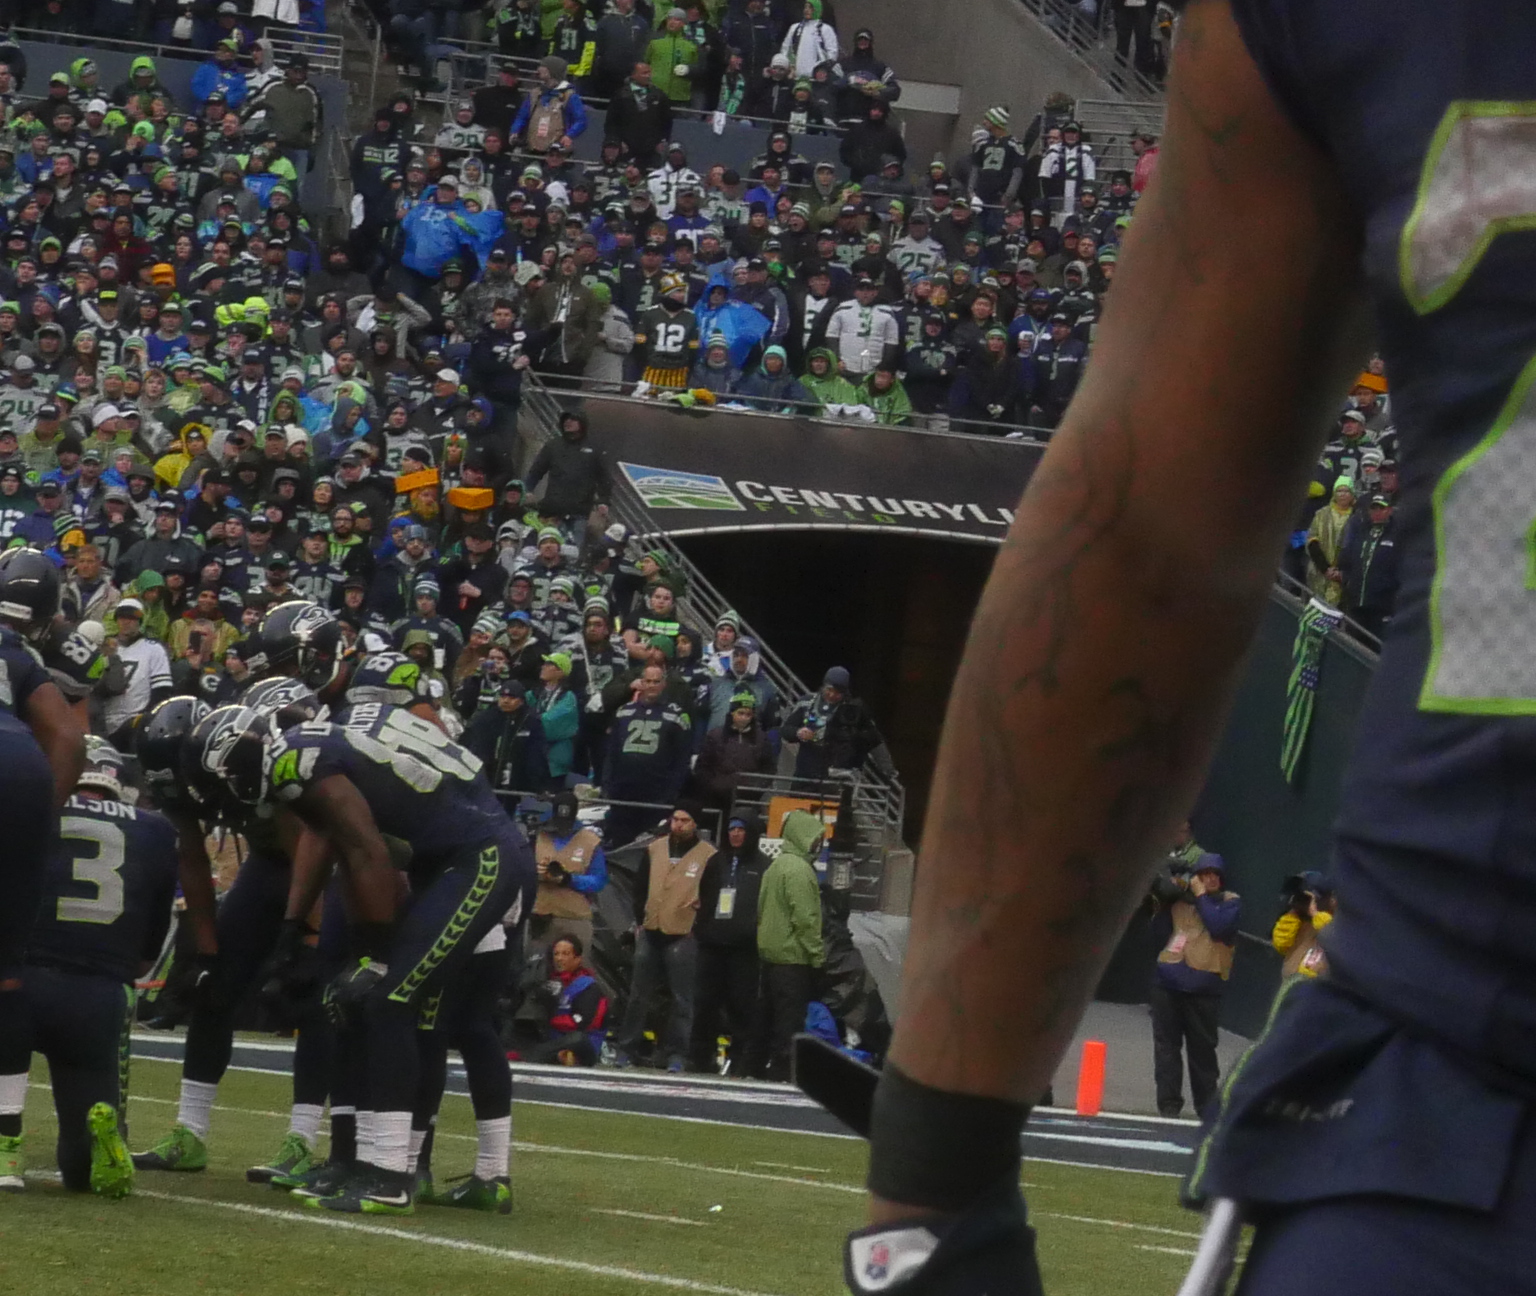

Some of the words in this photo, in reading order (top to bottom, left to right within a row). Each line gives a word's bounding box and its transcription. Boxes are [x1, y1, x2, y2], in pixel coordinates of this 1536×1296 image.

[897, 252, 931, 275] 25
[637, 285, 657, 312] 3
[654, 322, 686, 353] 12
[907, 315, 925, 343] 3
[2, 397, 37, 427] 24
[533, 577, 550, 609] 3
[623, 719, 664, 755] 25
[58, 816, 126, 925] 3
